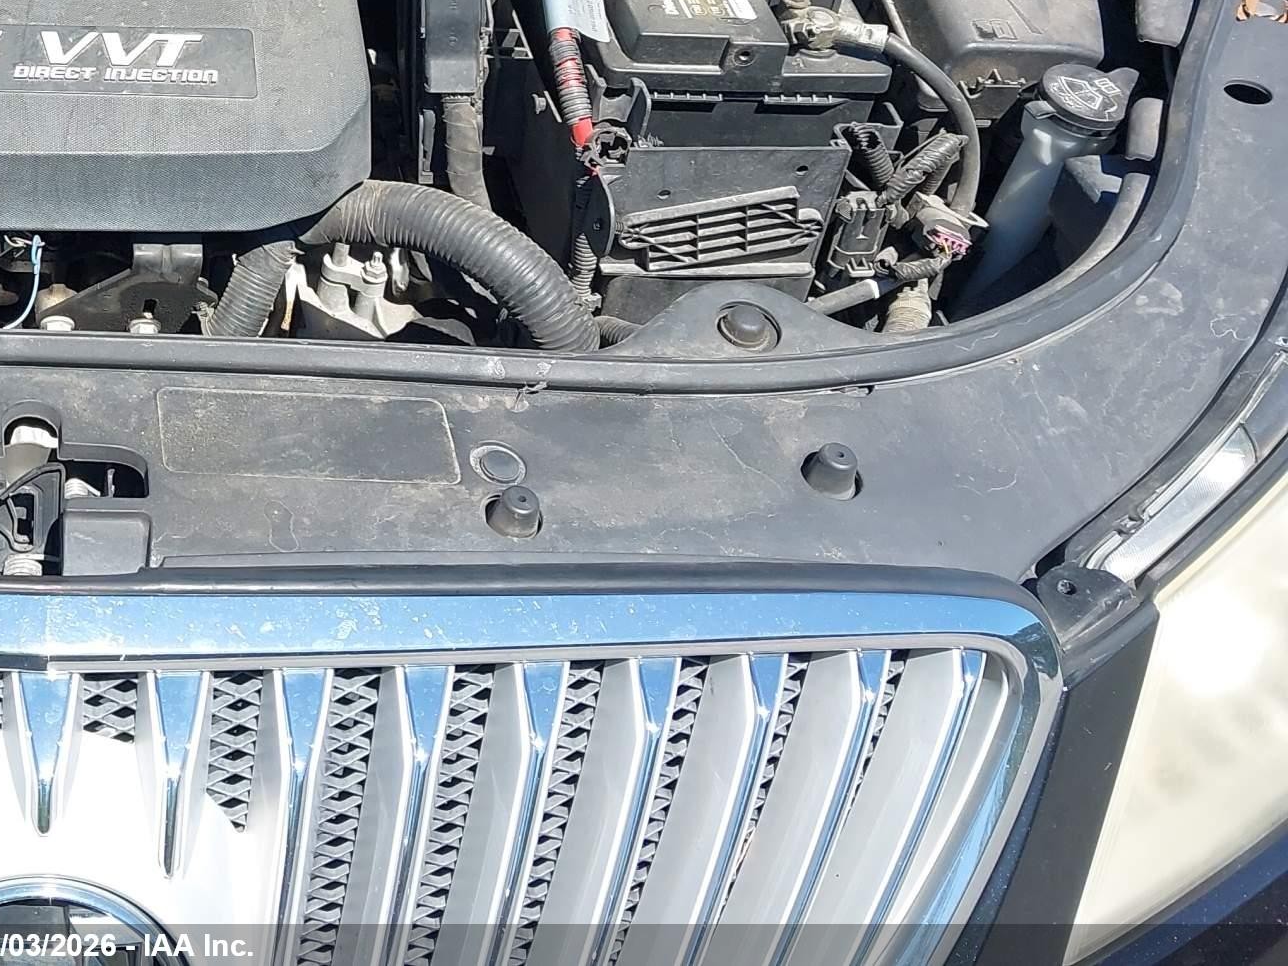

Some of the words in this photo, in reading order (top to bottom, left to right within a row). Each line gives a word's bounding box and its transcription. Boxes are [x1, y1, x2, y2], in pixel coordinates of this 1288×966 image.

[40, 31, 203, 67] VVT
[13, 63, 96, 81] DIRECT
[104, 66, 219, 84] INJECTION
